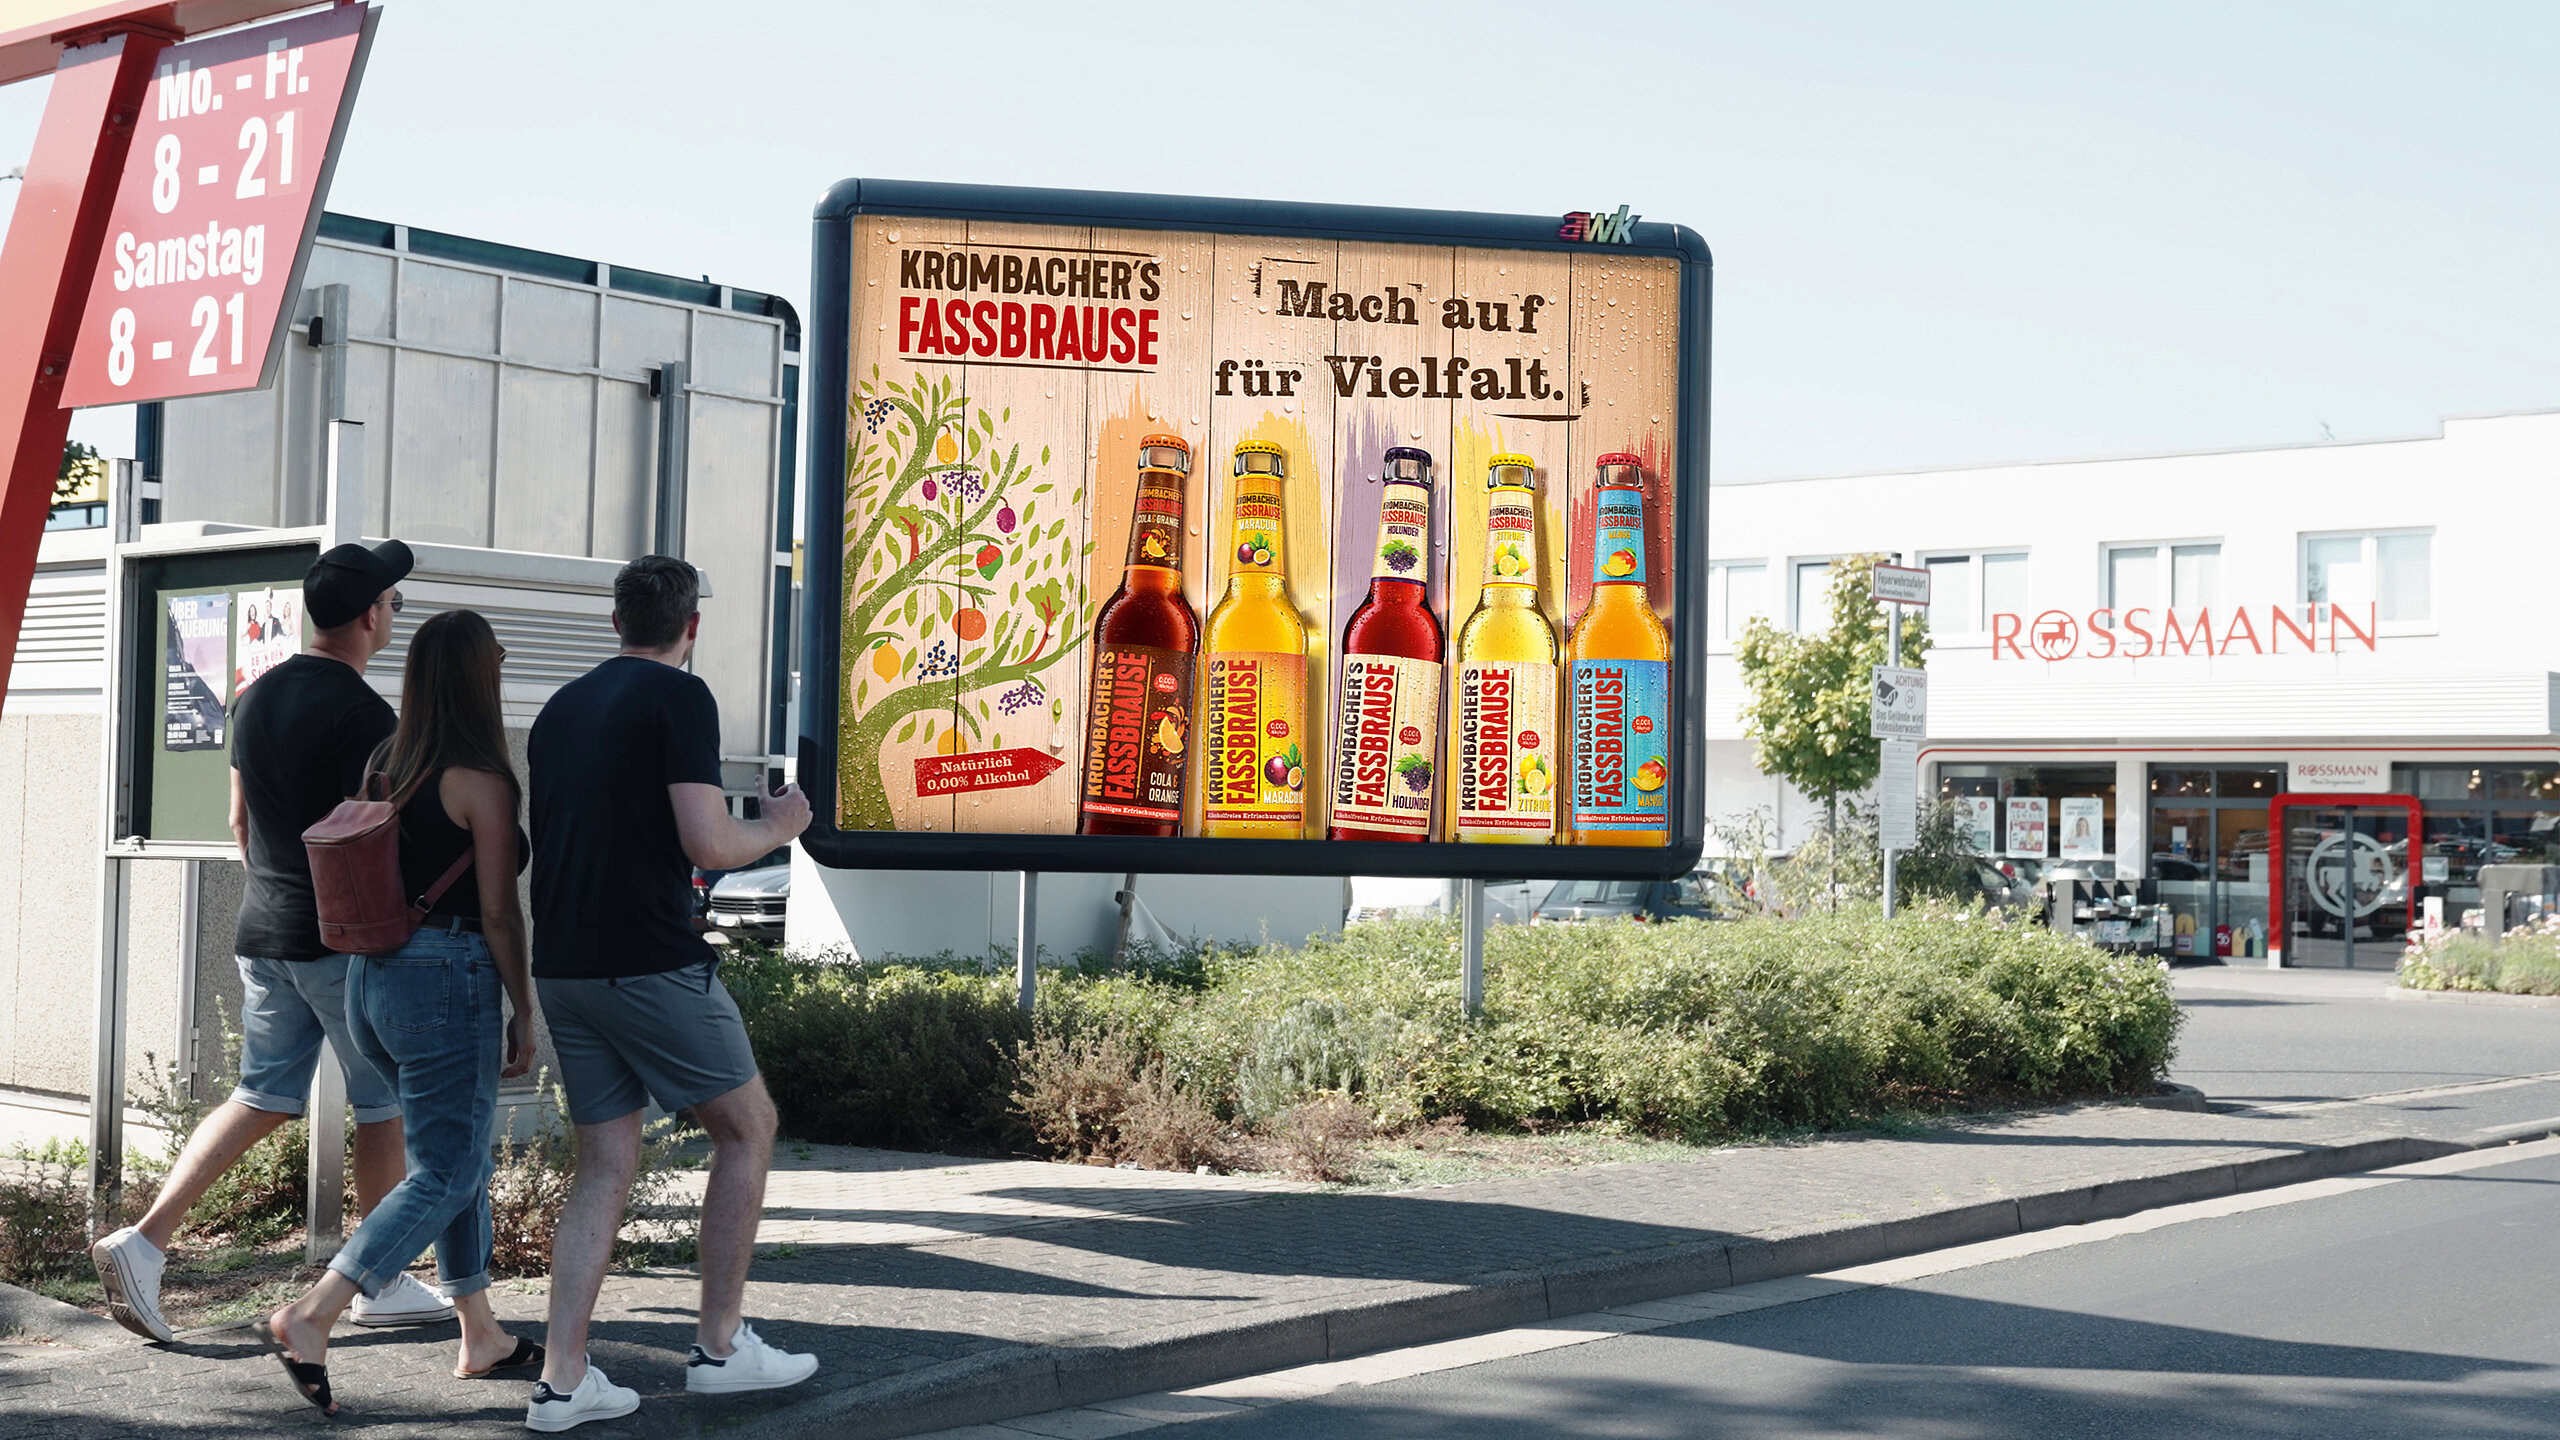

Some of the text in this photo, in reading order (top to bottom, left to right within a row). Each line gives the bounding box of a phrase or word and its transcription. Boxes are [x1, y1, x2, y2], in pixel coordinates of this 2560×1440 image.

[158, 38, 309, 121] Mo. - Fr.
[152, 110, 295, 214] 8 - 21
[1556, 205, 1642, 245] awk
[113, 220, 264, 292] Samstag
[1276, 279, 1545, 334] Mach auf
[107, 292, 244, 386] 8 - 21
[899, 296, 1159, 366] FASSBRAUSE
[1215, 356, 1564, 401] für Vielfalt.
[1137, 514, 1151, 524] COLA
[1157, 515, 1179, 528] ORANGE
[1235, 504, 1280, 520] FASSBRAUSE
[1382, 510, 1427, 528] FASSBRAUSE
[1239, 519, 1278, 532] MARACUJA
[1387, 525, 1419, 537] HOLUNDER
[1488, 516, 1533, 532] FASSBRAUSE
[1598, 515, 1642, 529] FASSBRAUSE
[1496, 531, 1525, 542] ZITRONE
[1608, 530, 1631, 539] MANGO
[1991, 601, 2376, 661] ROSSMANN
[1104, 652, 1148, 800] FASSBRAUSE
[1226, 659, 1257, 804] FASSBRAUSE
[1354, 663, 1395, 808] FASSBRAUSE
[1478, 669, 1510, 812] FASSBRAUSE
[1594, 667, 1623, 808] FASSBRAUSE
[940, 756, 1013, 774] Natürlich
[2298, 764, 2378, 776] ROSSMANN
[927, 769, 1030, 791] 0,00% Alkohol
[1150, 771, 1172, 786] COLA
[1149, 787, 1180, 804] ORANGE
[1392, 795, 1430, 811] HOLUNDER
[1637, 793, 1664, 808] MANGO
[1517, 797, 1552, 813] ZITRONE
